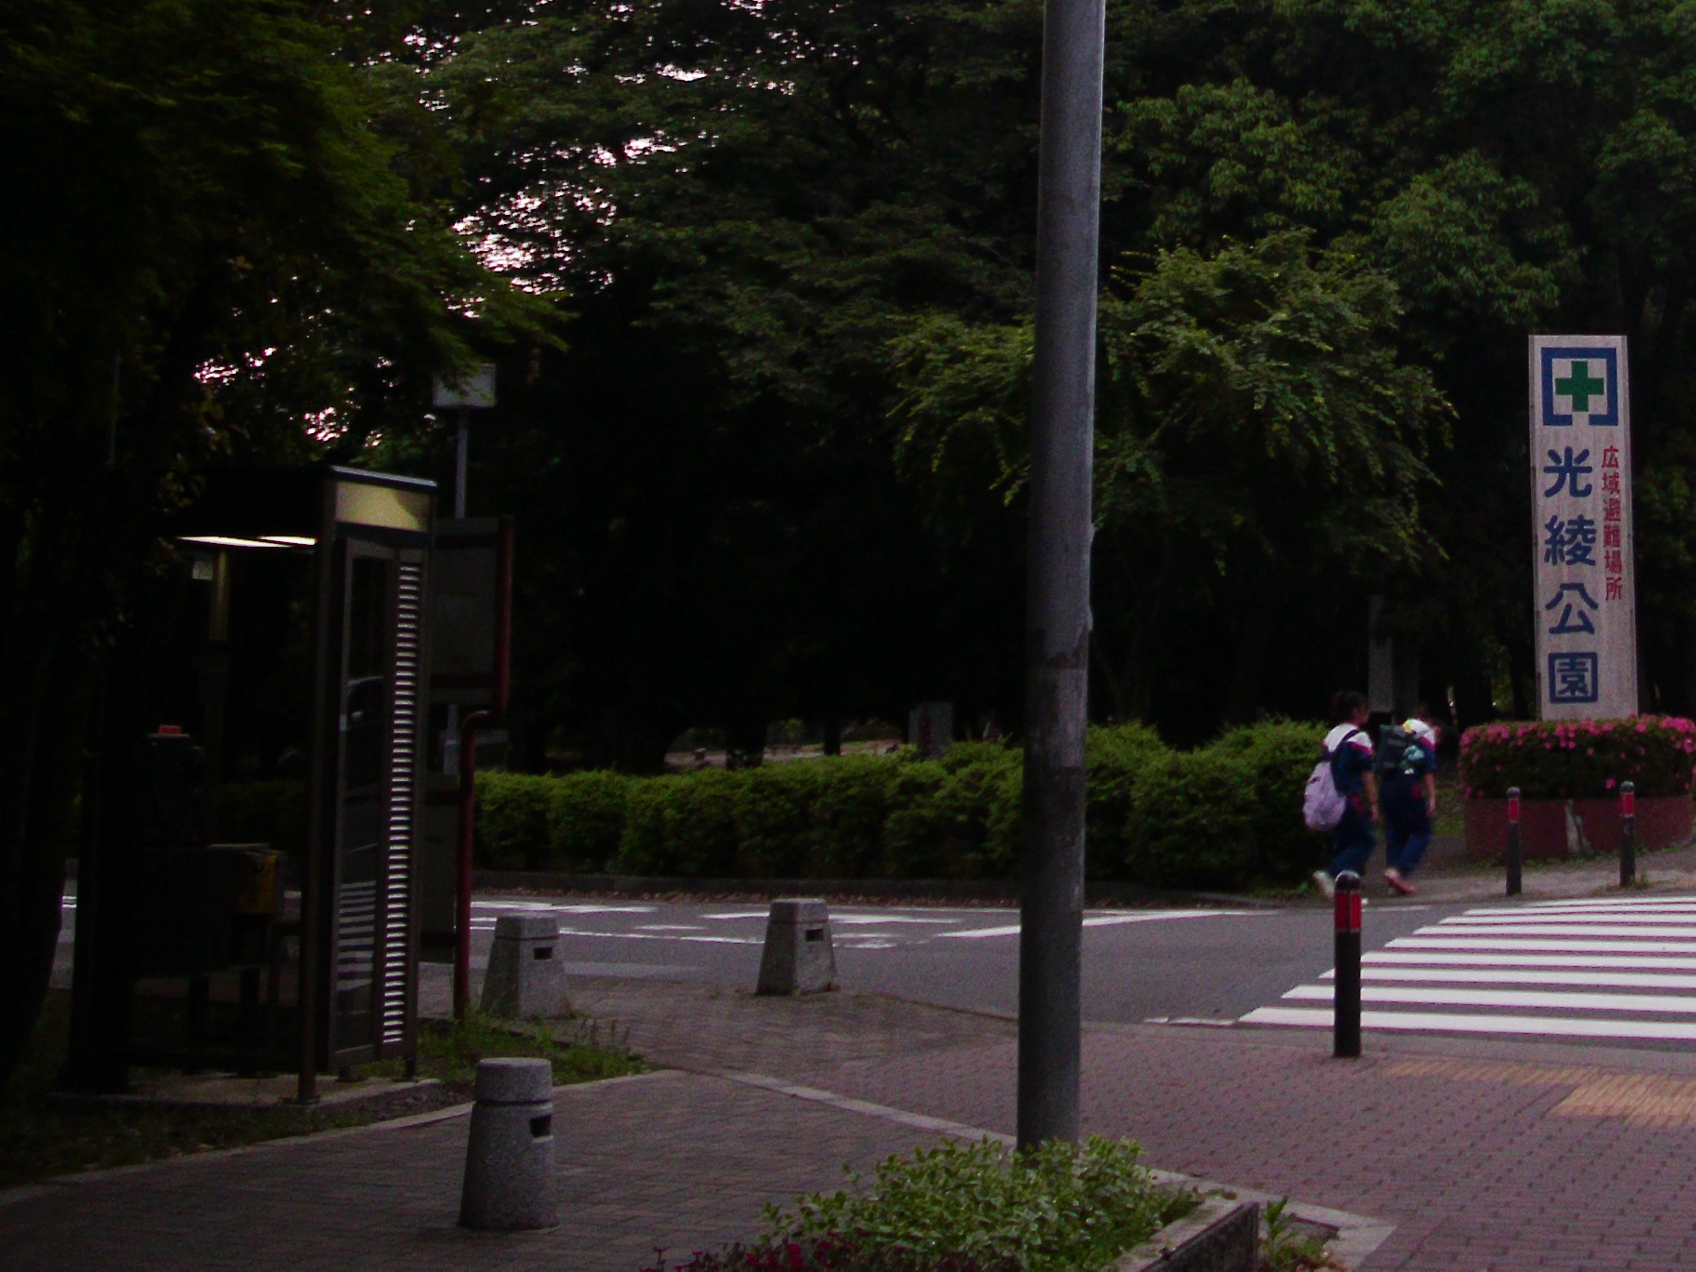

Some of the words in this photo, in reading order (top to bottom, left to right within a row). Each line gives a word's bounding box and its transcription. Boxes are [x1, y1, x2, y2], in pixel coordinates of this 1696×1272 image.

[1543, 445, 1600, 704] 光綾公園
[1601, 445, 1623, 601] 広域避難場所
